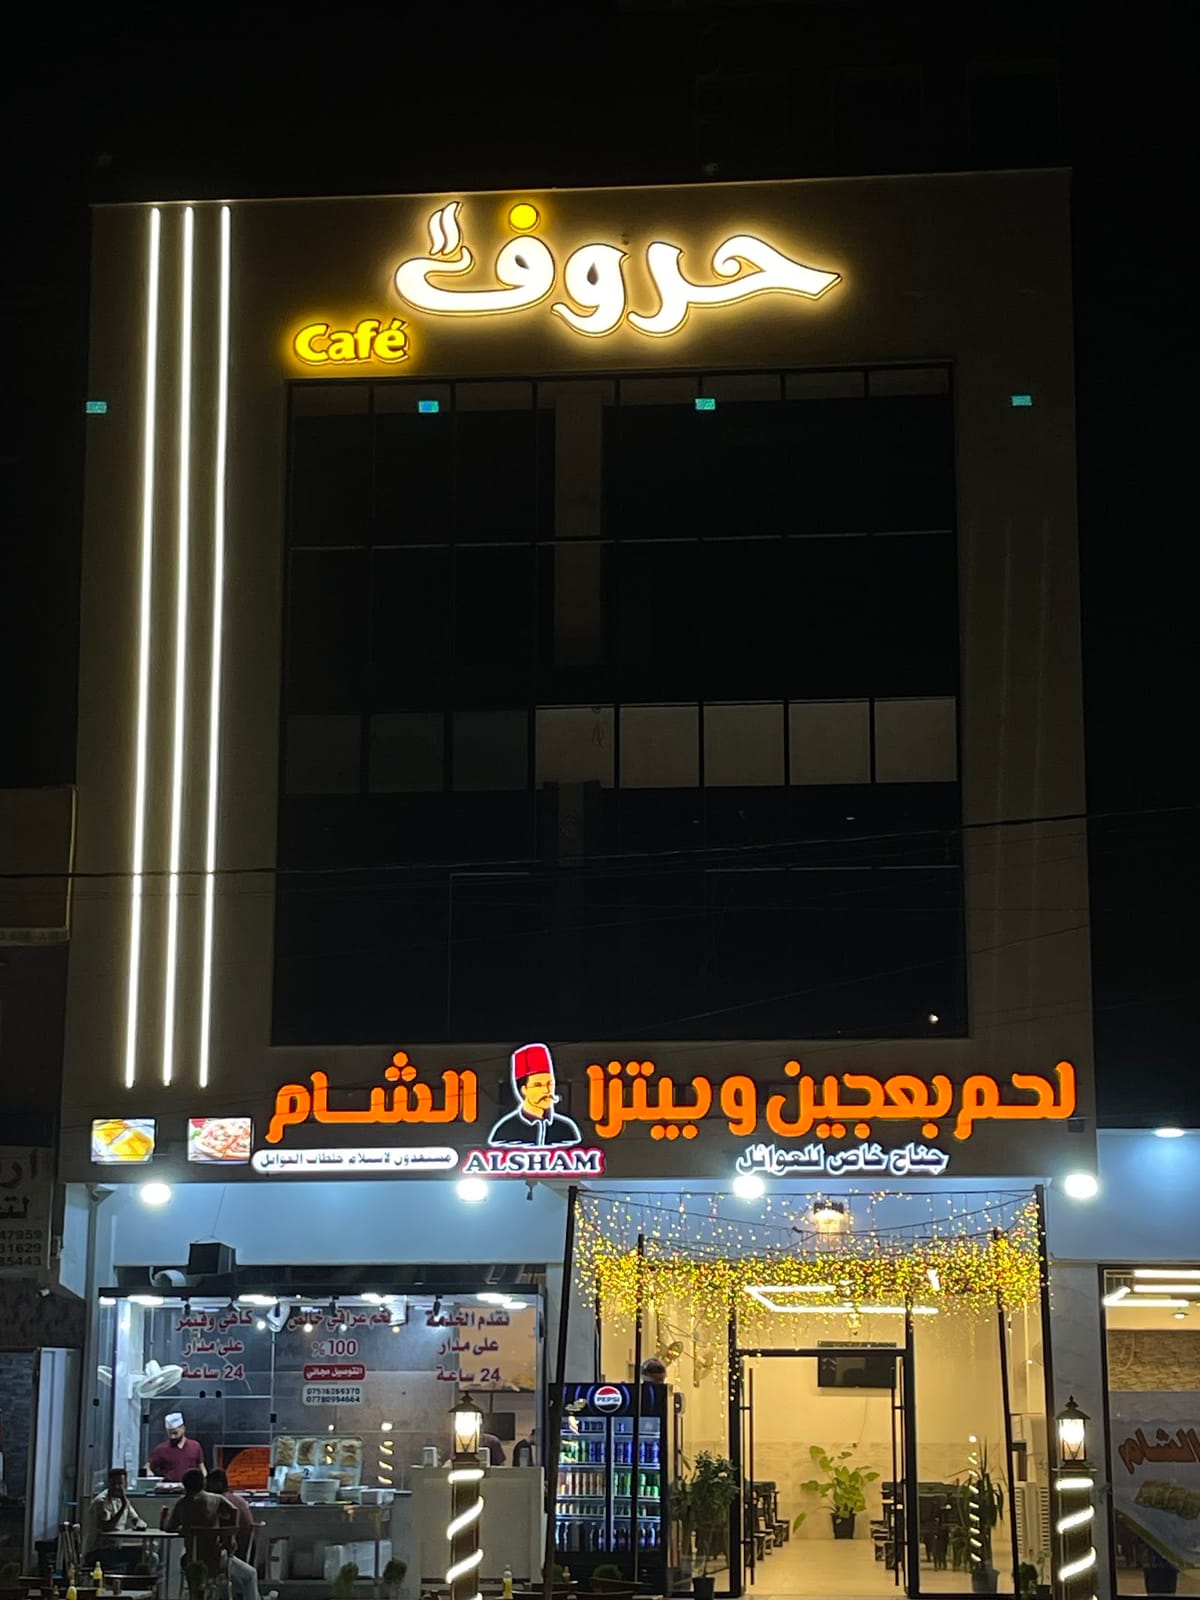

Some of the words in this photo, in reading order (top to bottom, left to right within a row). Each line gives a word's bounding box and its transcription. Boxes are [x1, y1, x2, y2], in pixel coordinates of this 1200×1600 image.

[394, 201, 842, 338] حروف
[294, 318, 409, 364] Café
[264, 1051, 478, 1144] الشام
[766, 1060, 952, 1138] بعجين
[953, 1060, 1077, 1140] لحم
[463, 1149, 604, 1174] ALSHAM
[736, 1143, 825, 1176] للعوائل
[826, 1142, 889, 1175] خاص
[890, 1142, 949, 1175] جناح
[218, 1309, 254, 1333] كاهي
[183, 1338, 216, 1357] مدار
[217, 1337, 245, 1357] على
[437, 1337, 471, 1356] مدار
[472, 1337, 499, 1356] على
[181, 1362, 220, 1379] ساعة
[223, 1363, 244, 1380] 24
[435, 1364, 476, 1382] ساعة
[479, 1367, 502, 1383] 24
